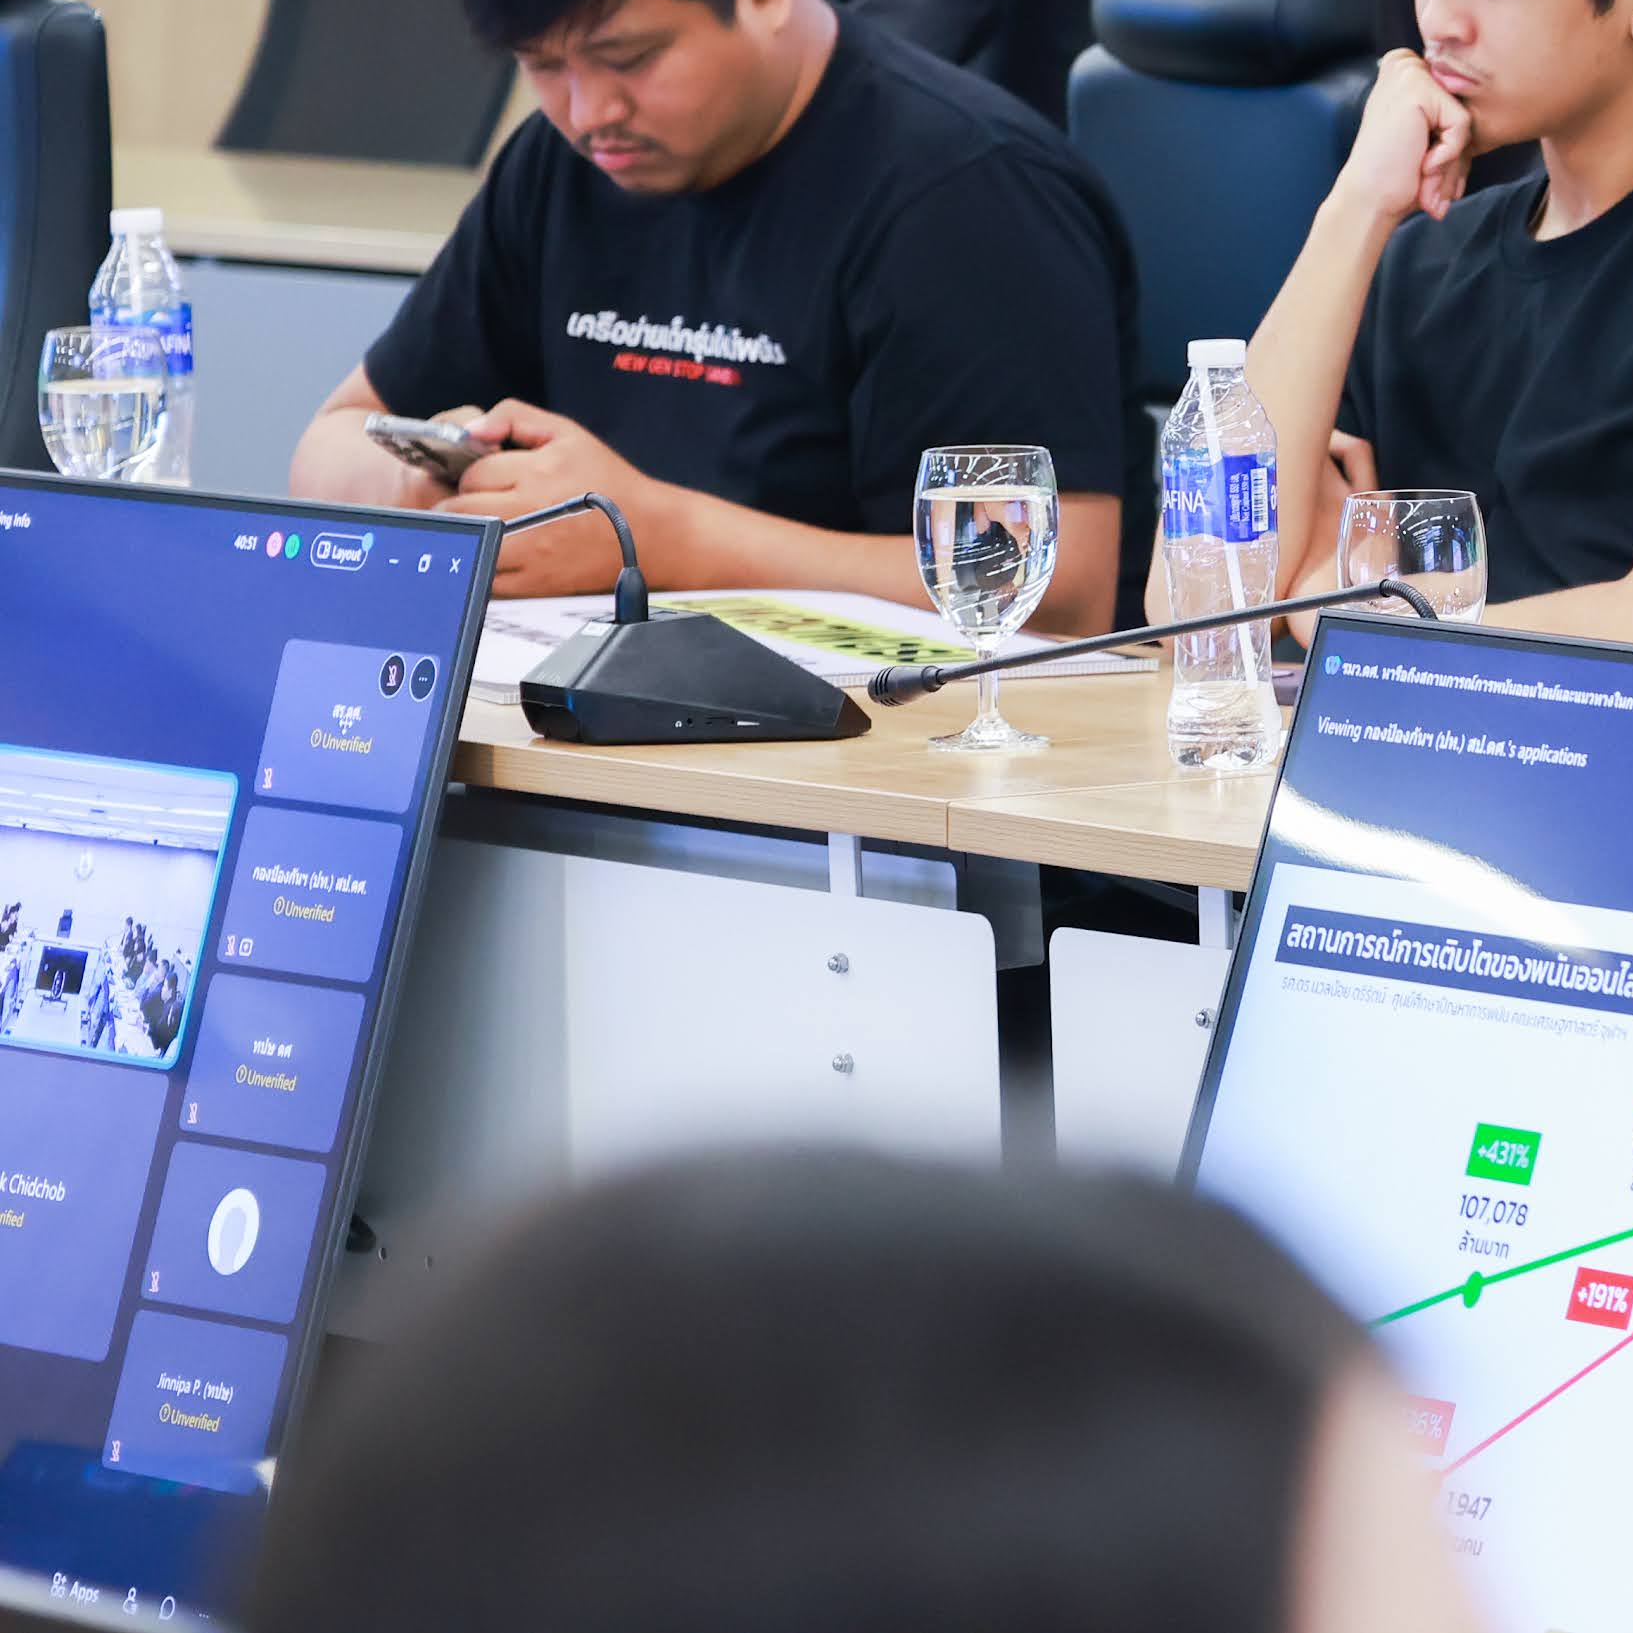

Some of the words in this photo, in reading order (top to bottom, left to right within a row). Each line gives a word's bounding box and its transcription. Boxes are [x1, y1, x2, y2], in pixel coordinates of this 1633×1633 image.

[1163, 488, 1208, 515] AFINA
[331, 542, 362, 565] Layout
[322, 733, 373, 754] Unverified
[1318, 716, 1361, 743] Viewing
[1517, 743, 1588, 769] applications
[285, 900, 335, 922] Unverified
[247, 1068, 297, 1093] Unverified
[1477, 1139, 1530, 1169] +431%
[9, 1173, 65, 1202] Chidchob
[1459, 1194, 1529, 1227] 107,078
[1577, 1282, 1629, 1313] +191%
[157, 1372, 190, 1397] Jinnipa
[171, 1408, 221, 1433] Unverified
[69, 1580, 100, 1604] Apps
